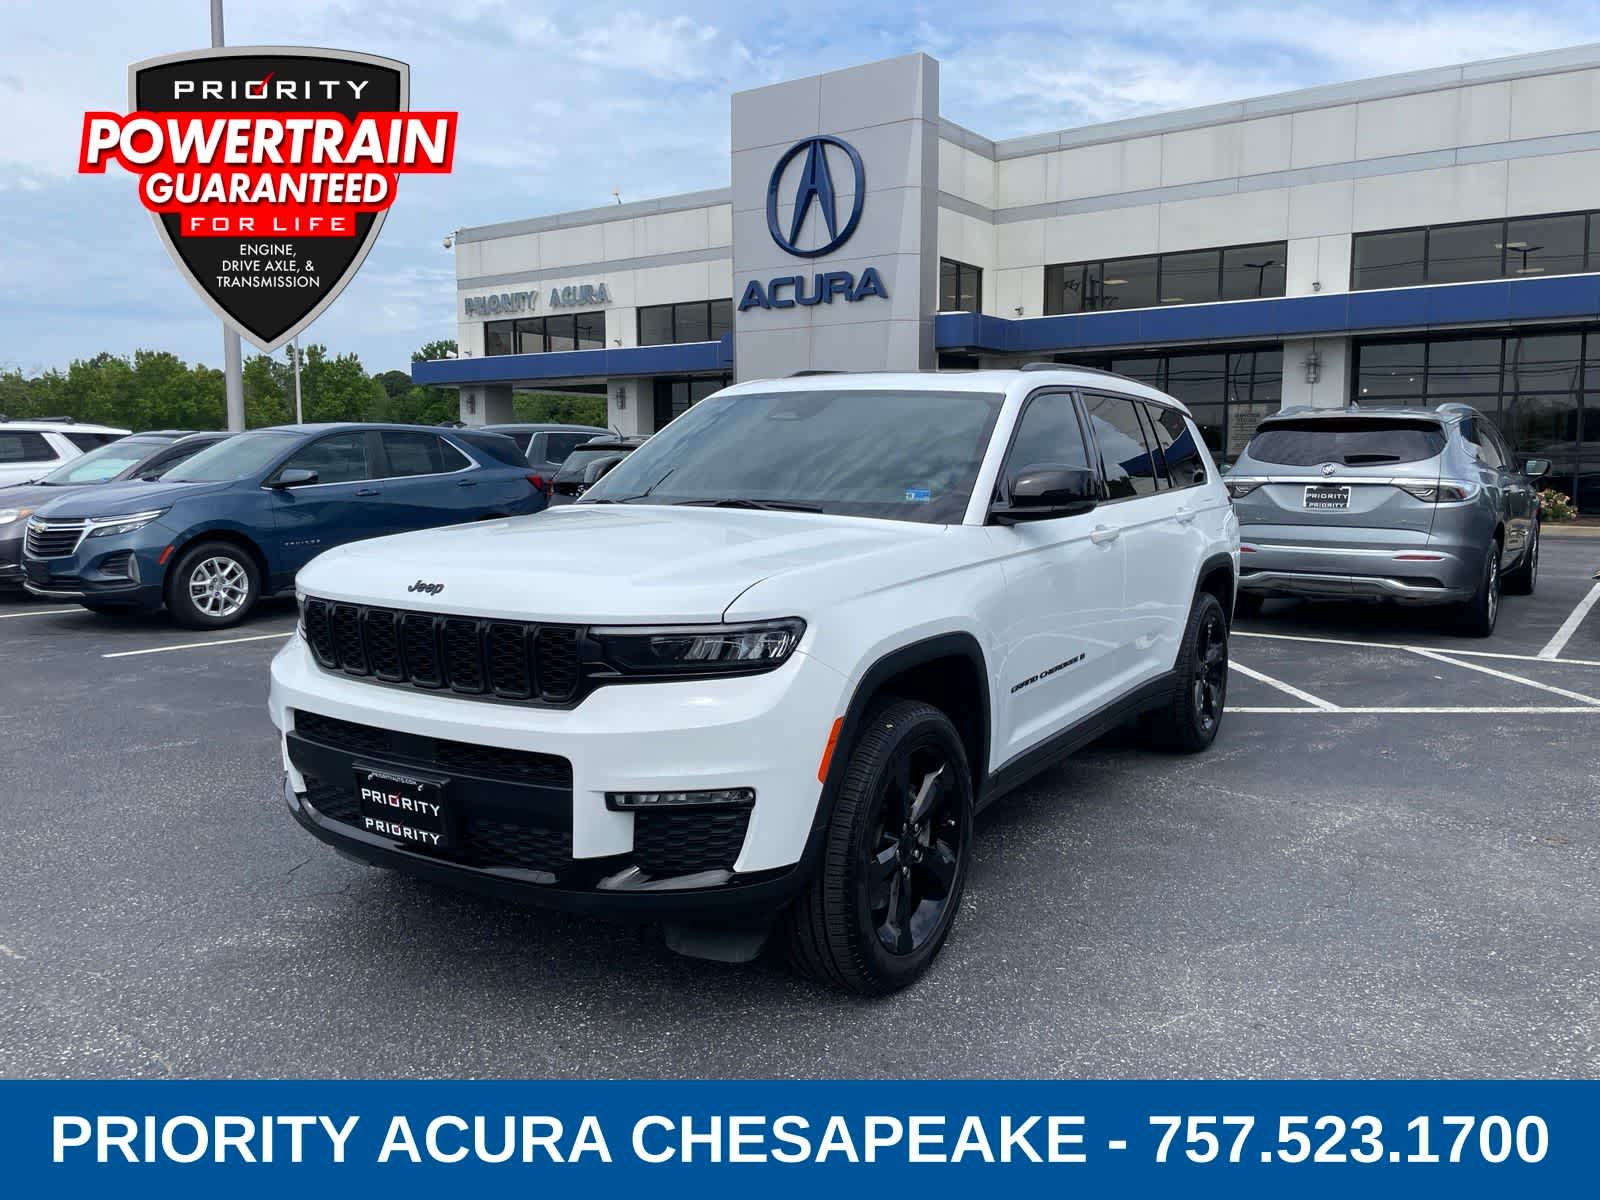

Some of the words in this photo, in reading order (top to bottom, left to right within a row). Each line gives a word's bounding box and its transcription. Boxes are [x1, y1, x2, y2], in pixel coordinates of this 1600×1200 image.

[464, 291, 538, 317] PRIORITY
[549, 283, 611, 308] ACURA
[738, 266, 889, 312] ACURA
[407, 579, 445, 597] Jeep
[361, 787, 441, 817] PRIORITY
[364, 817, 441, 846] PRIORITY
